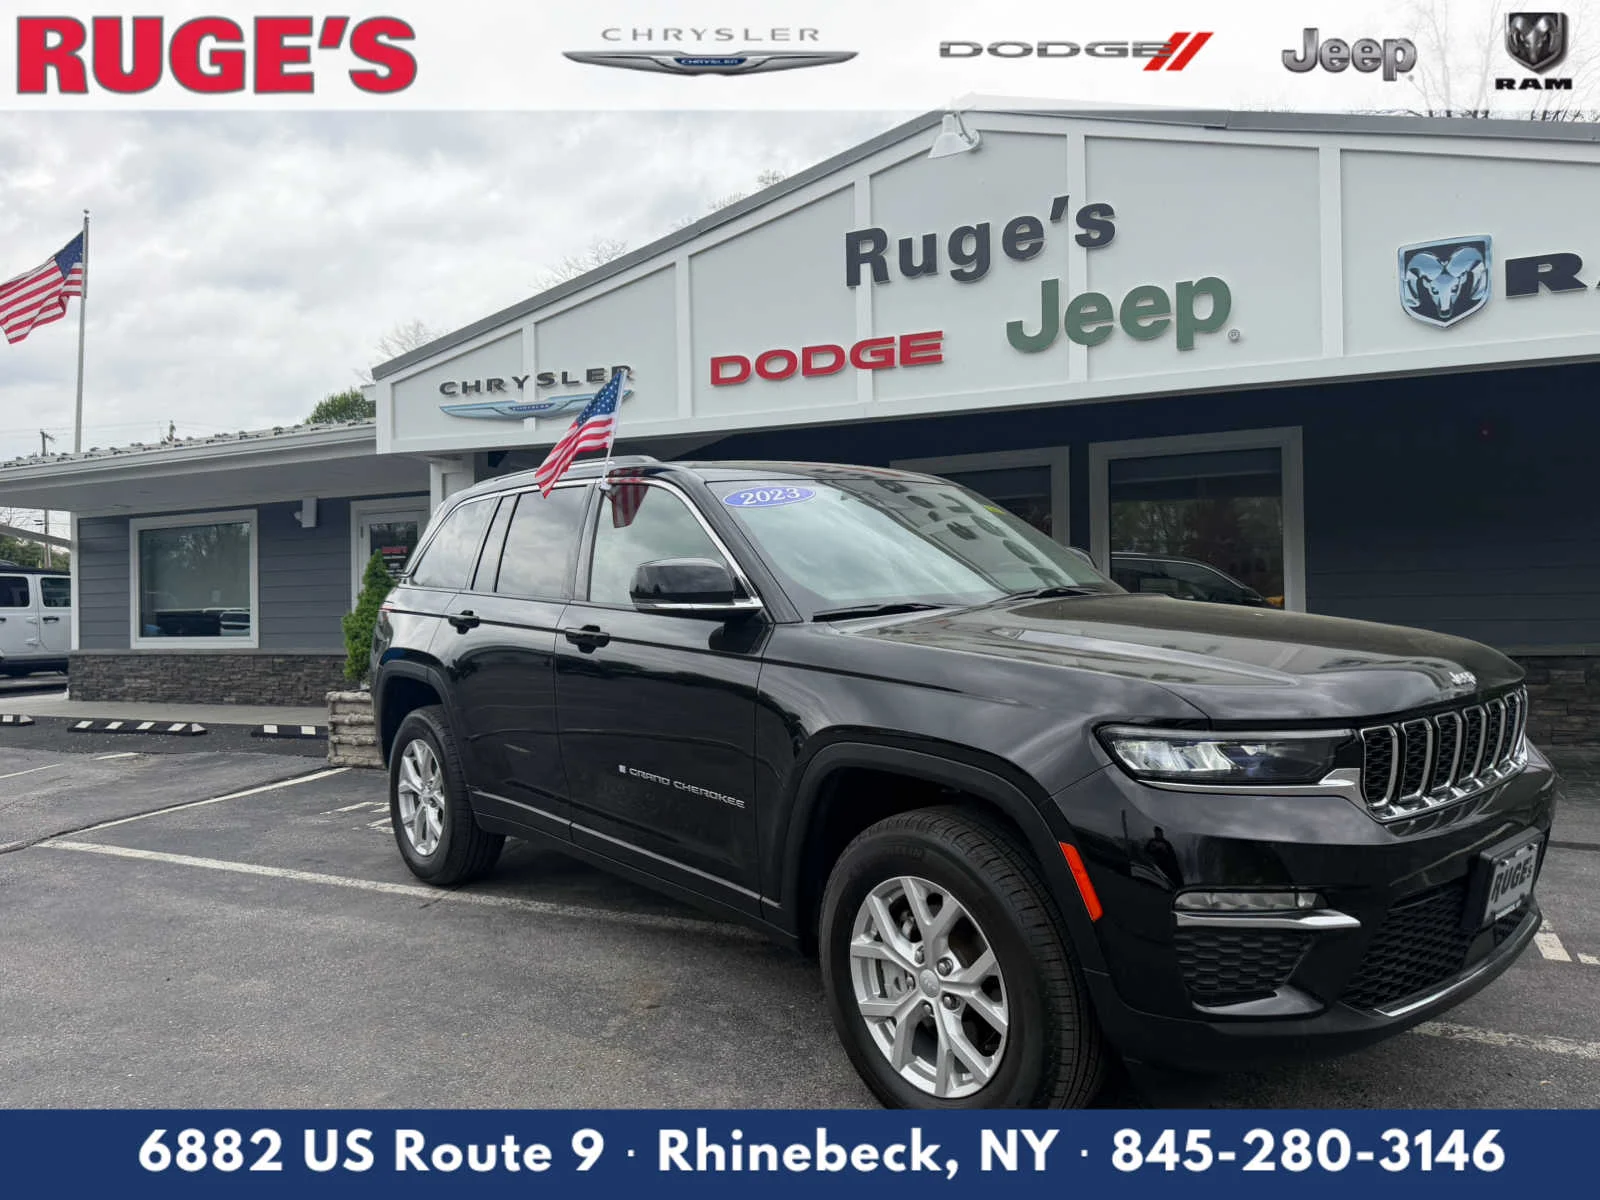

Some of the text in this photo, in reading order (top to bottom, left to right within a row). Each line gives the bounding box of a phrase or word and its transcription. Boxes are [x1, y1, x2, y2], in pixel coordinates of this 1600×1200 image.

[845, 194, 1117, 288] Ruge's
[1504, 252, 1600, 298] R
[1006, 276, 1232, 354] Jeep
[439, 365, 634, 396] CHRYSLER
[711, 331, 944, 386] DODGE
[740, 487, 801, 505] 2023
[628, 767, 746, 809] GRAND CHEROKEE
